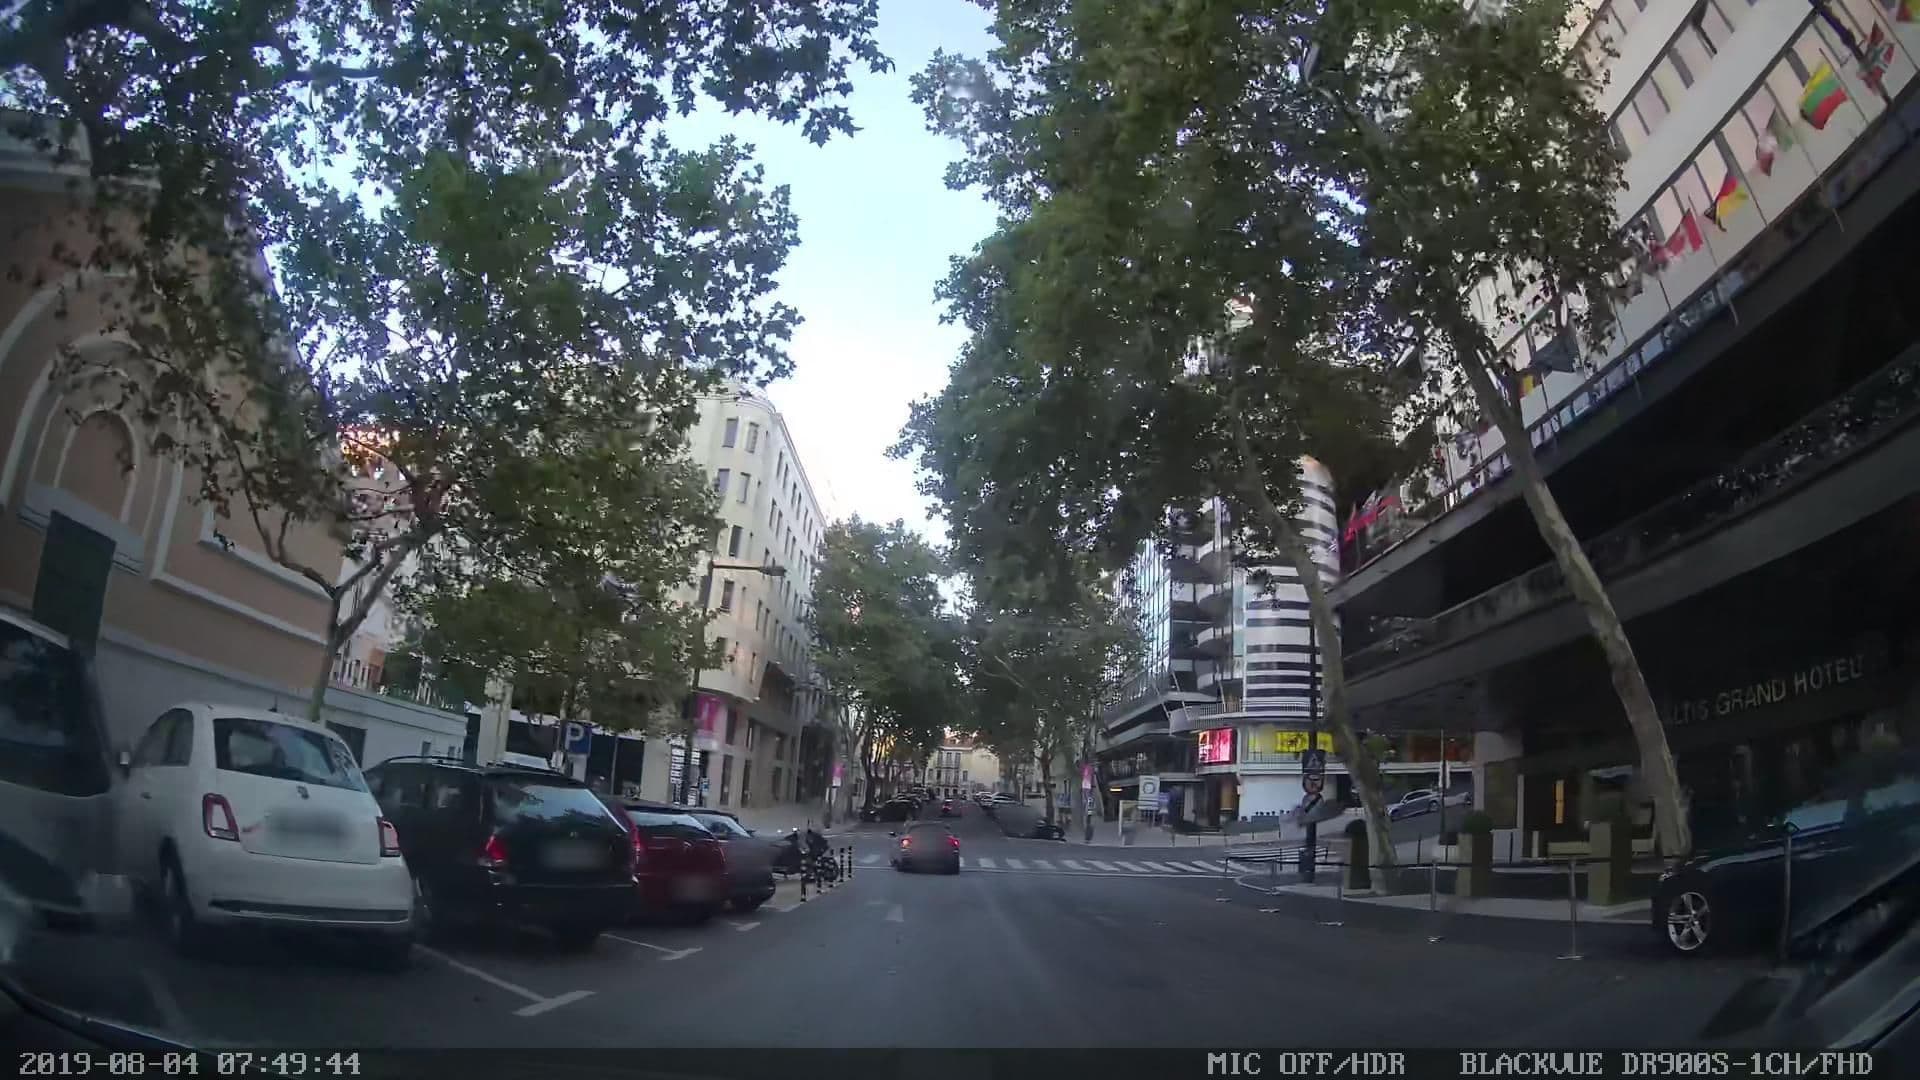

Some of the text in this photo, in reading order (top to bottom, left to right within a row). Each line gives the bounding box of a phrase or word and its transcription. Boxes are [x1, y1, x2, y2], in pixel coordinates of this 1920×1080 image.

[1714, 680, 1787, 713] GRAND
[1793, 655, 1863, 695] HOTEL
[565, 722, 585, 750] P
